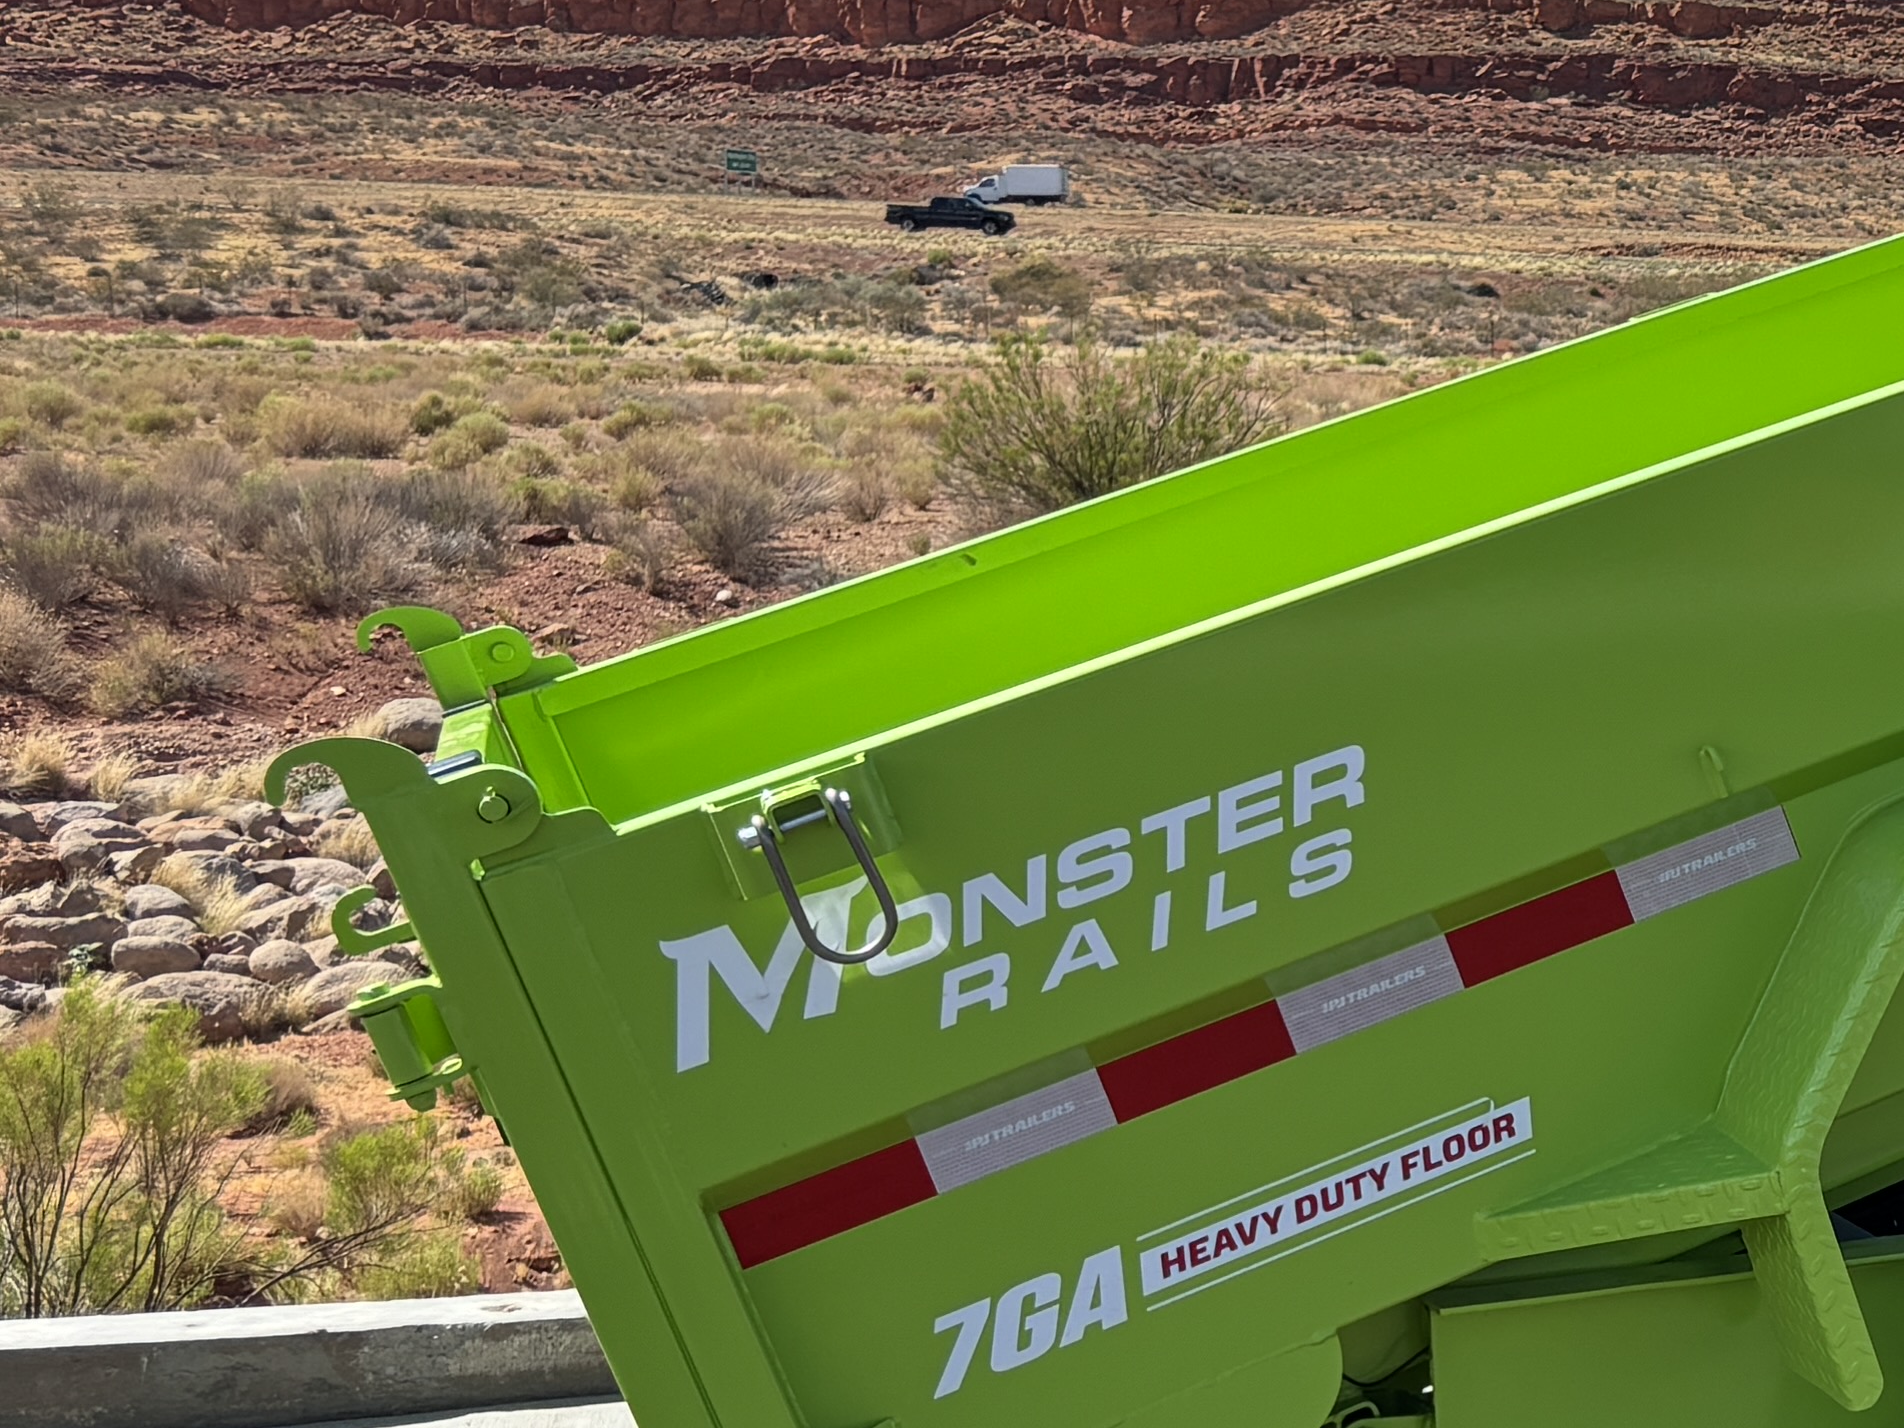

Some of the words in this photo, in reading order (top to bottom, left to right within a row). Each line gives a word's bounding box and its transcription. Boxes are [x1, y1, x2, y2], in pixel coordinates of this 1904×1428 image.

[657, 744, 1366, 1073] MONSTER
[940, 827, 1353, 1030] RAILS
[1682, 837, 1758, 874] TRAILERS
[1346, 965, 1427, 1004] TRAILERS
[991, 1100, 1076, 1142] TRAILERS
[1159, 1204, 1285, 1279] HEAVY
[1294, 1161, 1391, 1226] DUTY
[1400, 1111, 1517, 1181] FLOOR
[933, 1244, 1128, 1400] 7GA
